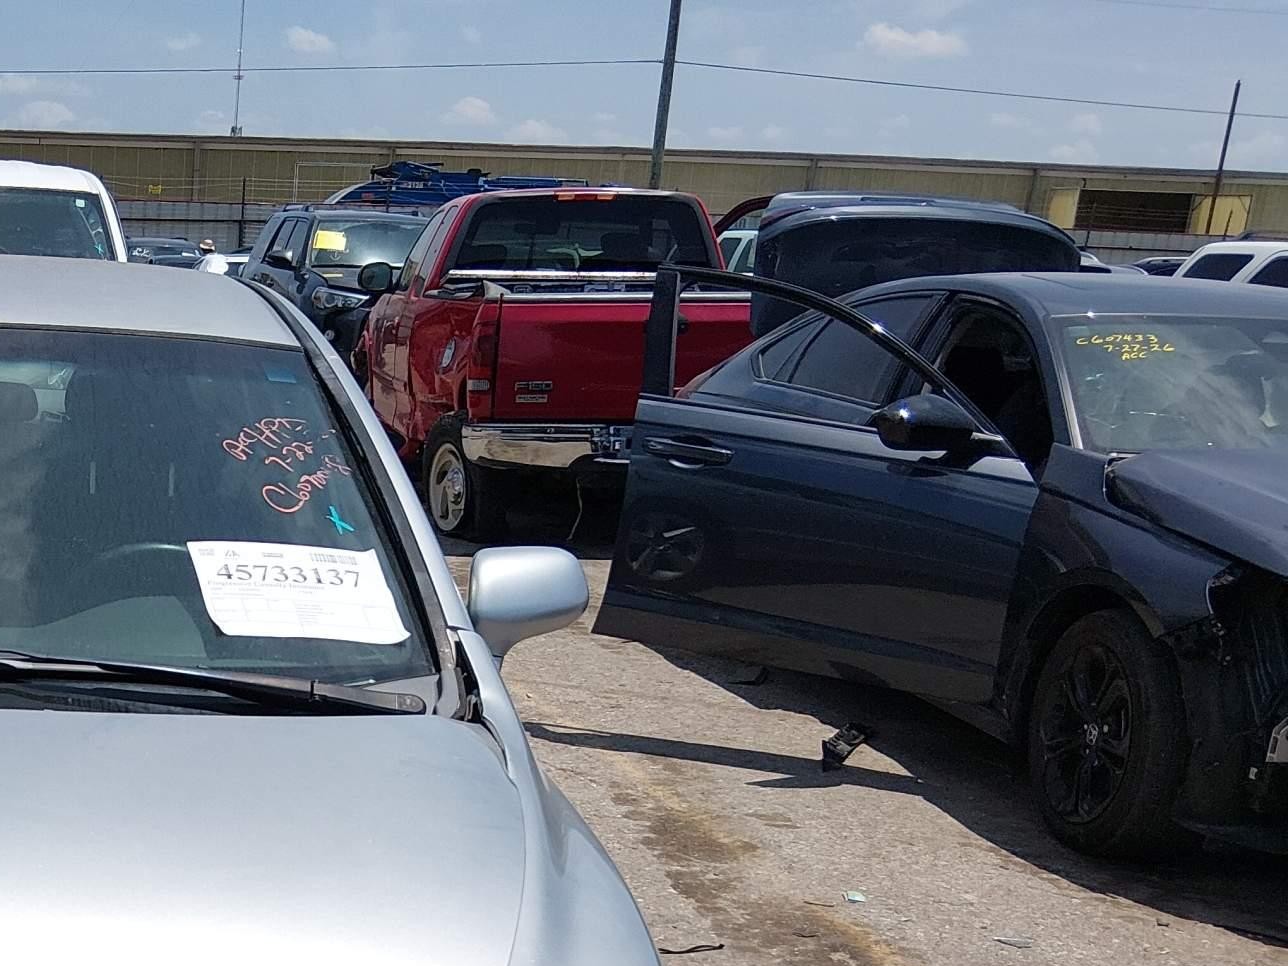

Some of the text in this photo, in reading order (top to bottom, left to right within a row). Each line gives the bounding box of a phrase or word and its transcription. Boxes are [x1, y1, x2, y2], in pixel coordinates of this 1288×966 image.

[1103, 343, 1176, 353] 7-27-26
[1121, 351, 1148, 361] ACC
[215, 563, 360, 588] 45733137
